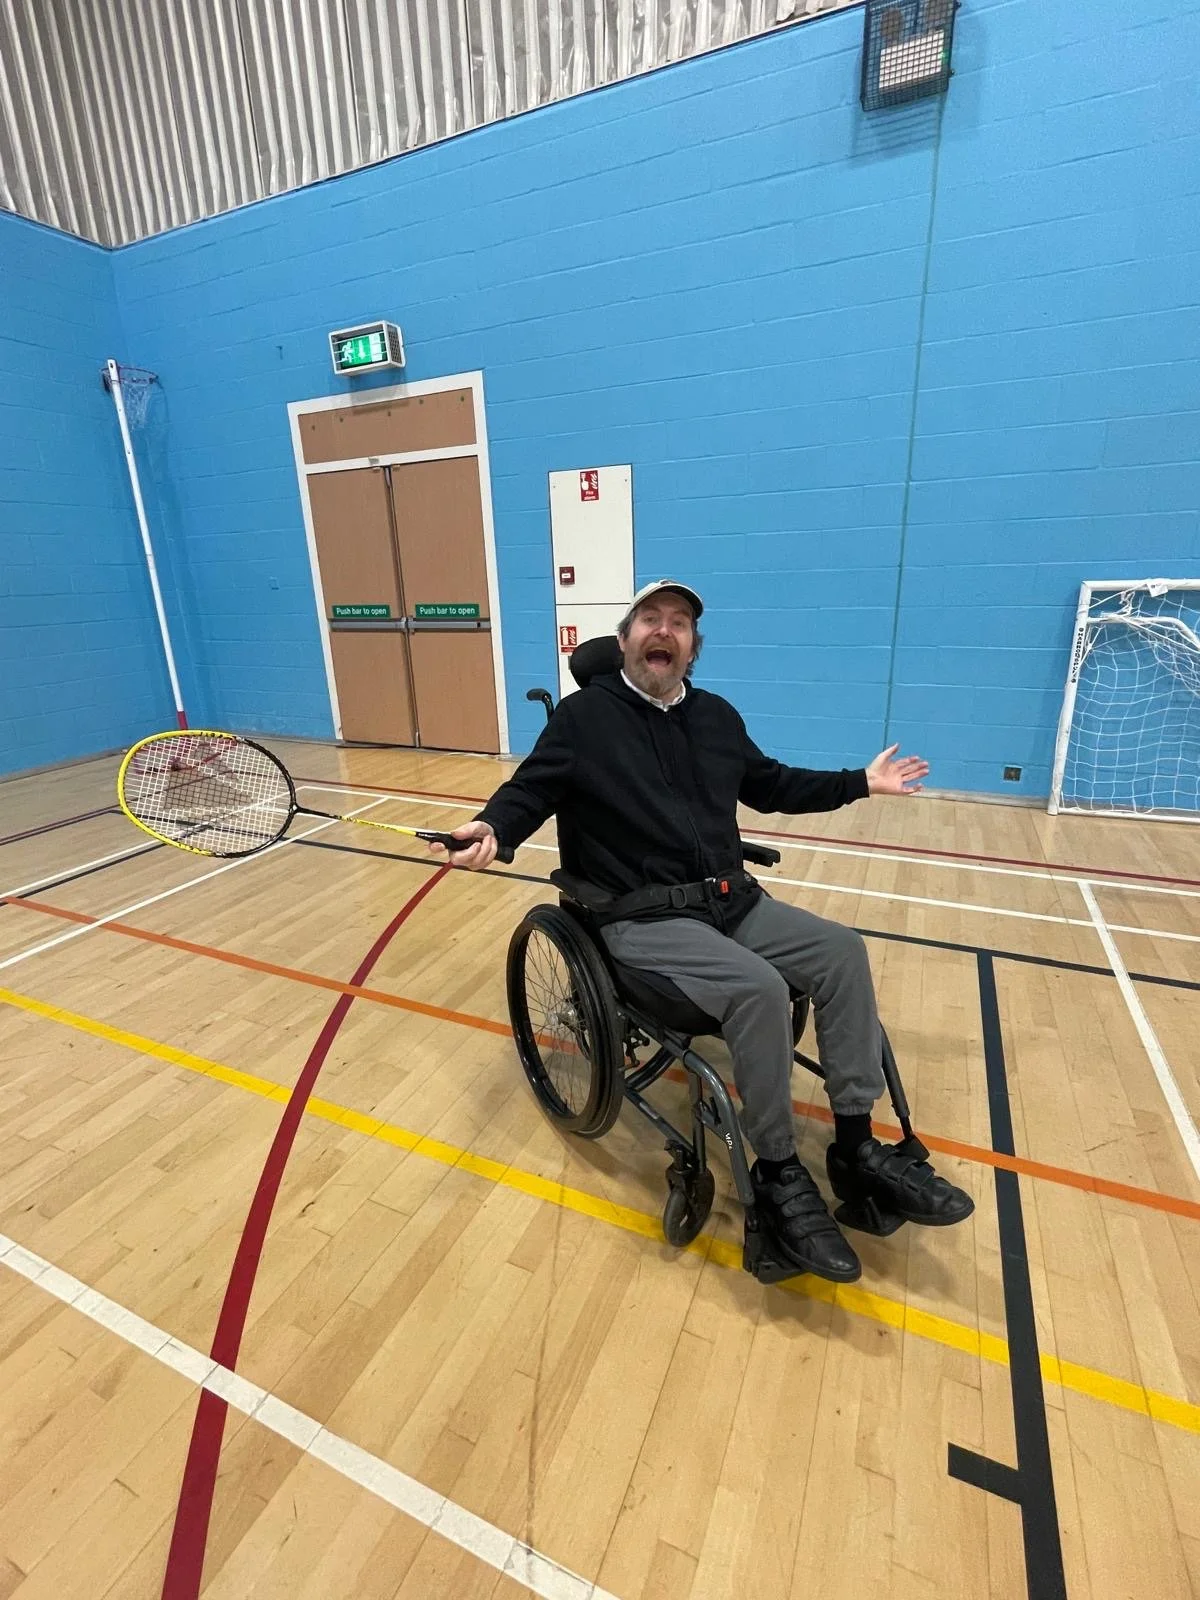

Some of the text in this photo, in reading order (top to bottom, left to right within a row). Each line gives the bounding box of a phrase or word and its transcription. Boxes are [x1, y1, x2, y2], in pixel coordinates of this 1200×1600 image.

[336, 607, 387, 616] Push bar to open
[419, 606, 475, 616] Push bar to open
